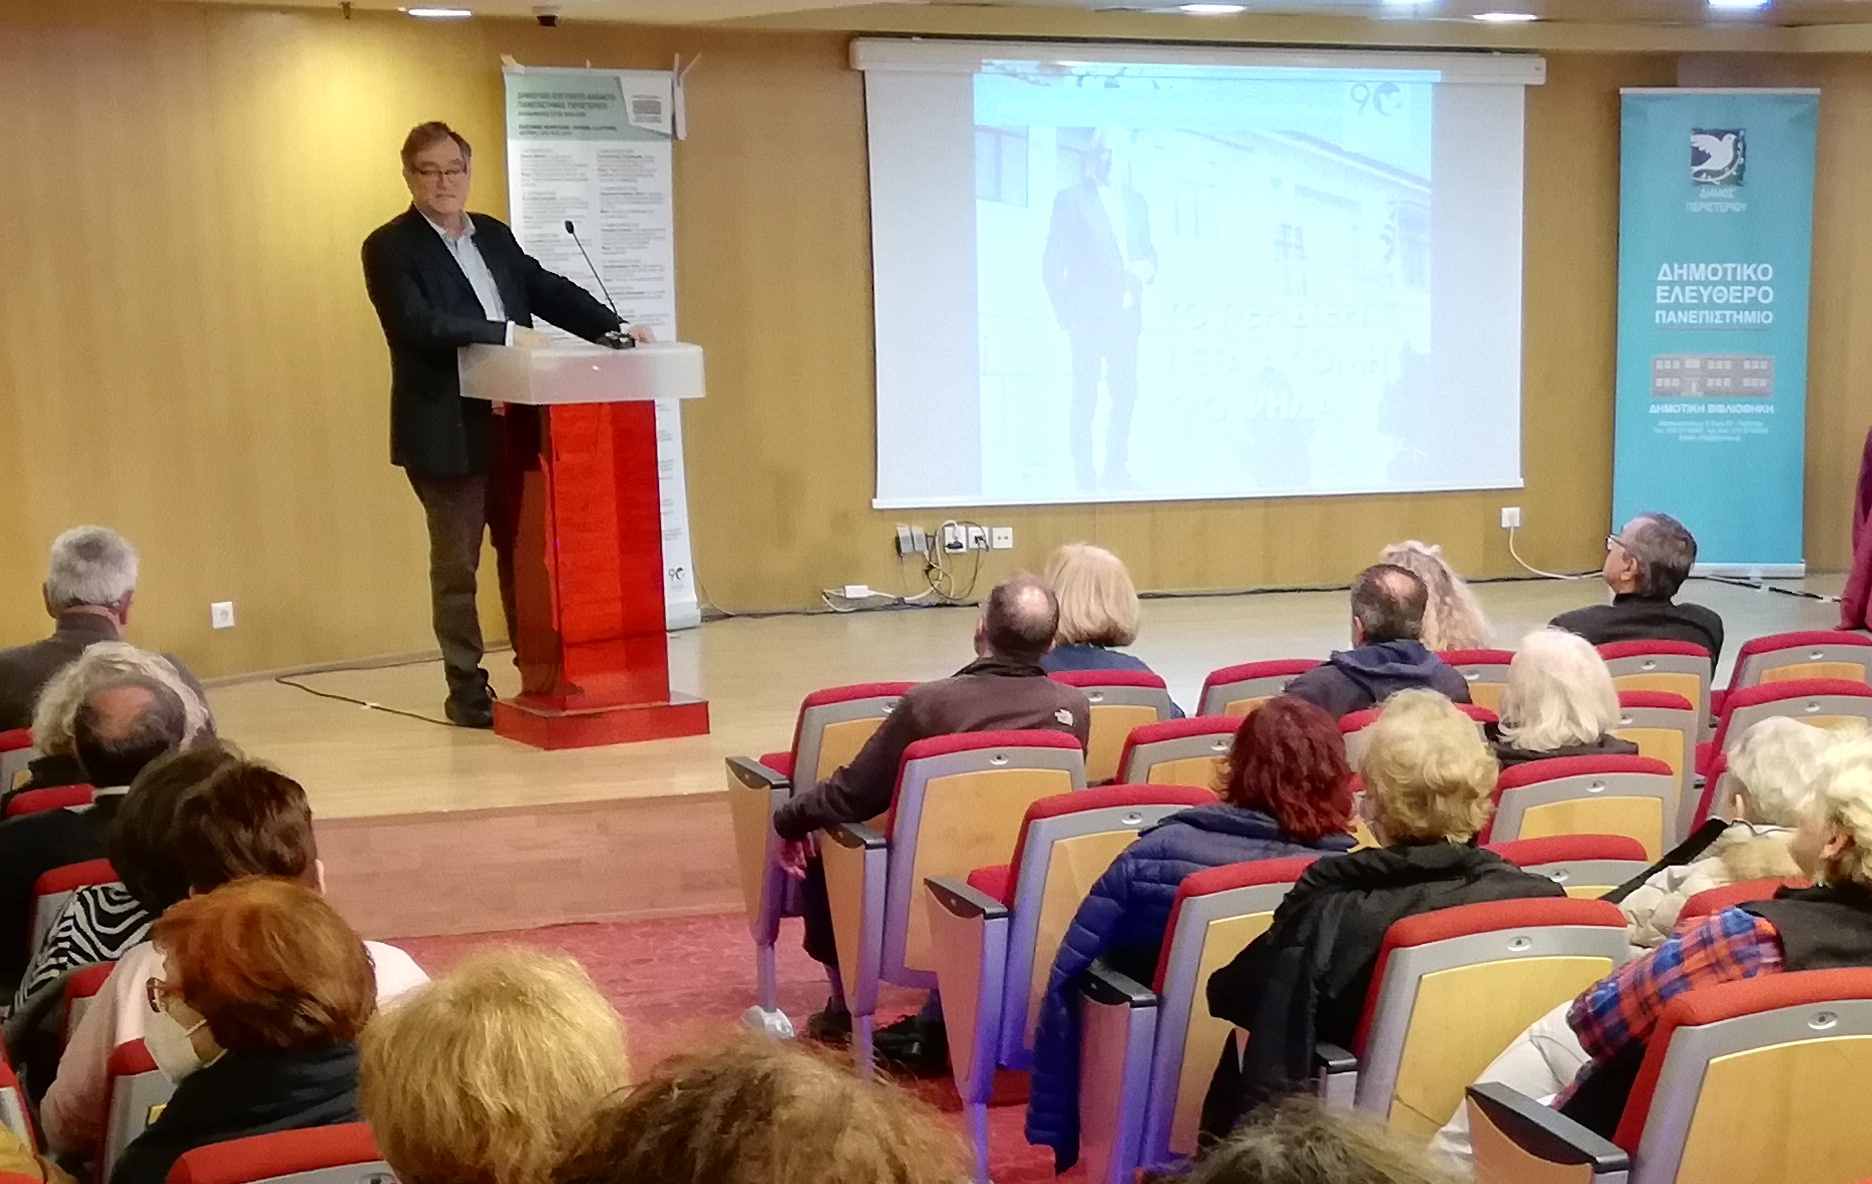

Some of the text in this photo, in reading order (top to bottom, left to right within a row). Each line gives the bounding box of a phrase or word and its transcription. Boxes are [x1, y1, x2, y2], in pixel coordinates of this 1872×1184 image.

[1657, 263, 1774, 281] ΔΗΜΟΤΙΚΟ
[1656, 285, 1775, 304] ΕΛΕΥΘΕΡΟ
[1655, 310, 1774, 324] ΠΑΝΕΠΙΣΤΗΜΙΟ
